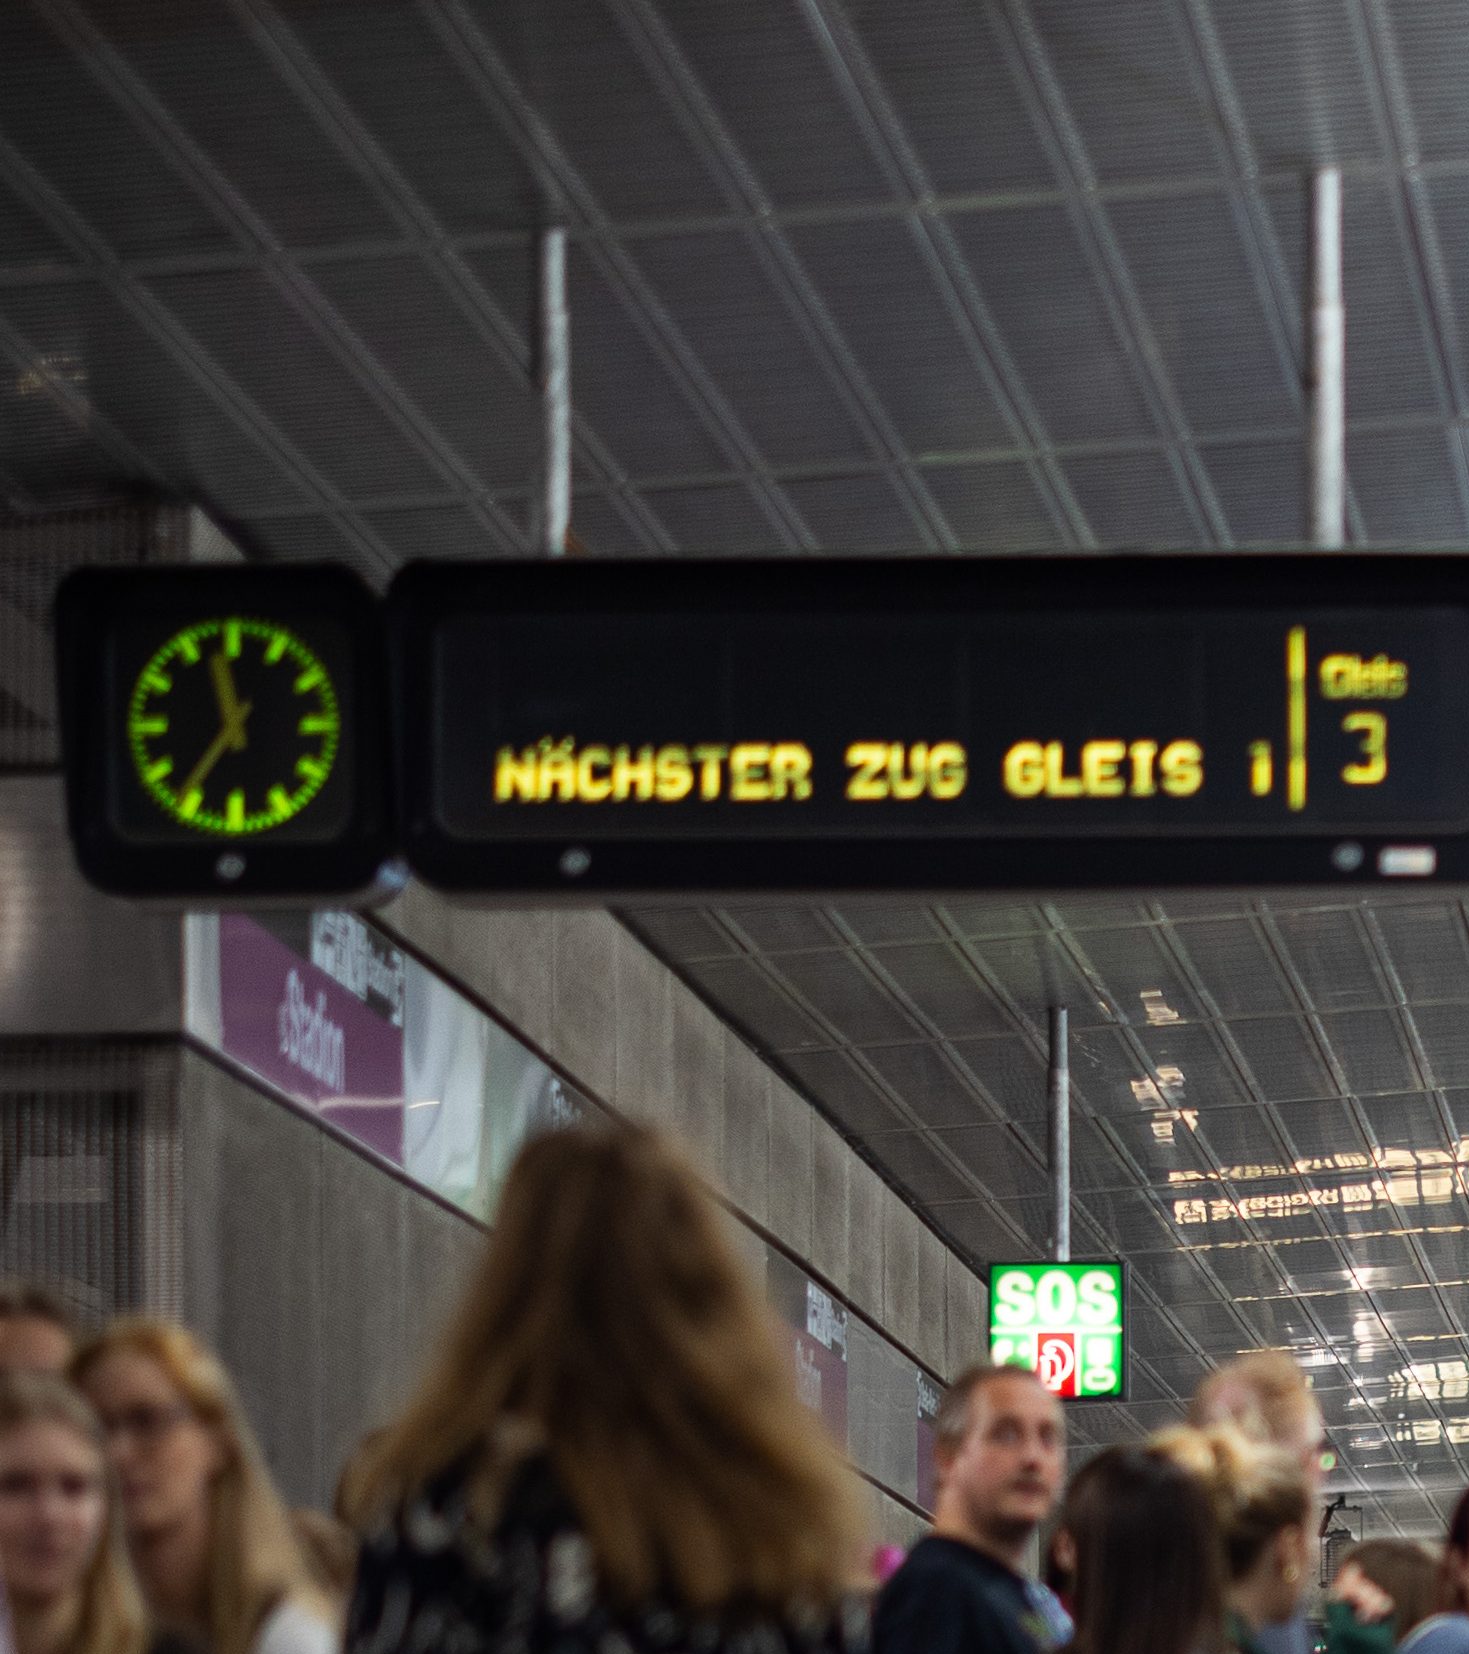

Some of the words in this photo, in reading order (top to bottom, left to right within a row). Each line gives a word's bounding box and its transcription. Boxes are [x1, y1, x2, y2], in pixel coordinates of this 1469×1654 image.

[494, 736, 813, 803] NÄCHSTER
[845, 741, 967, 801] ZUG
[1003, 739, 1204, 799] GLEIS
[1341, 711, 1388, 785] 3
[993, 1269, 1119, 1326] SOS
